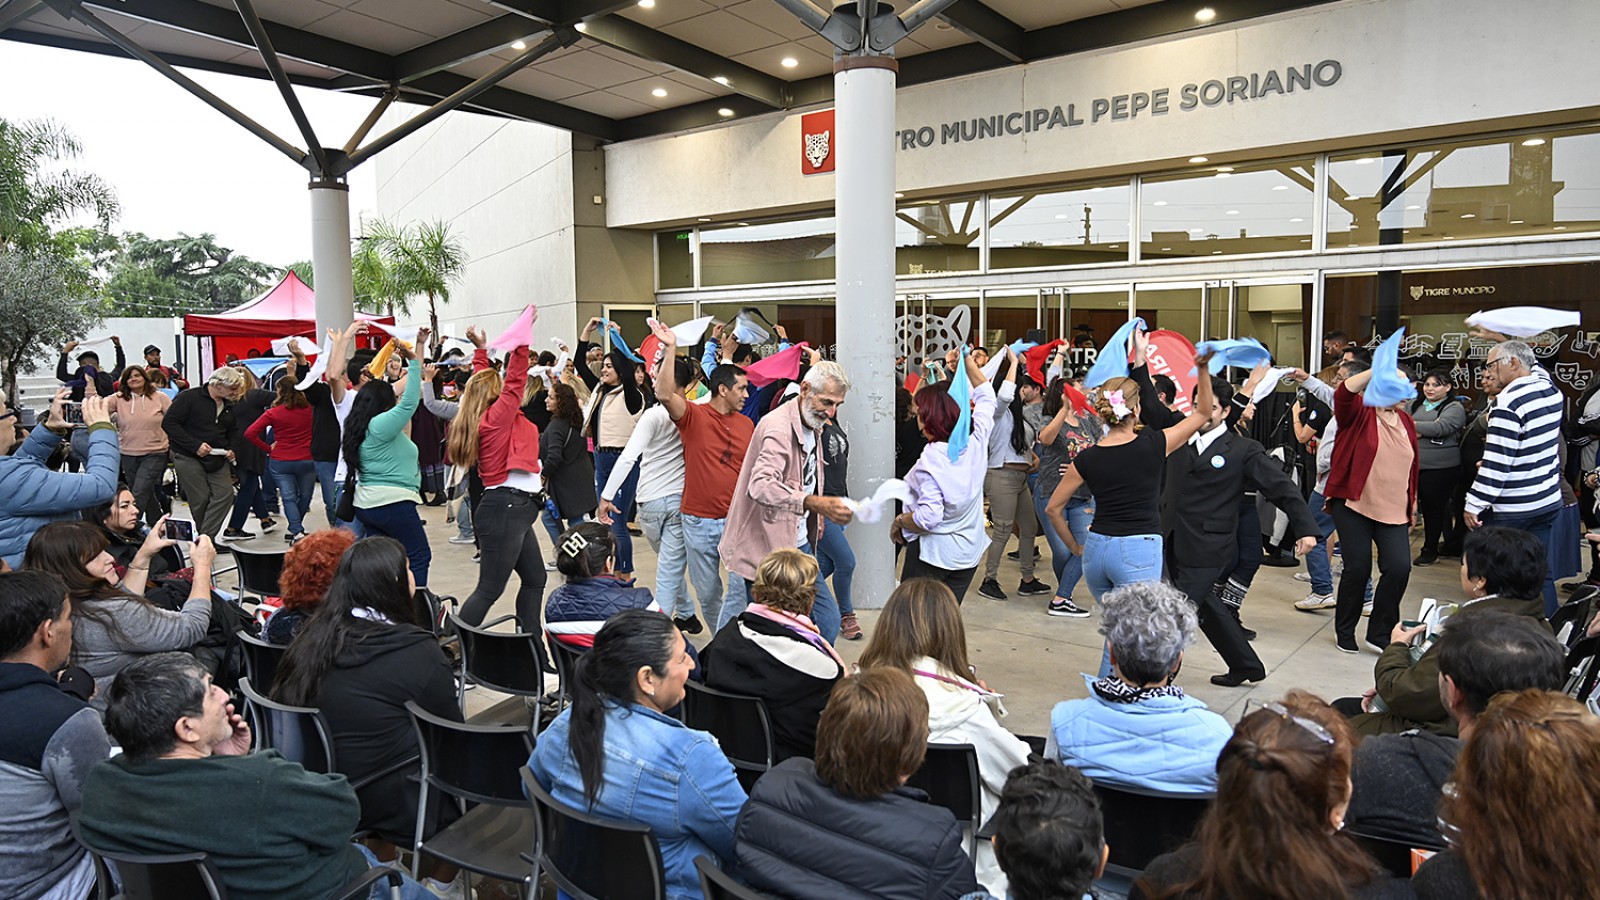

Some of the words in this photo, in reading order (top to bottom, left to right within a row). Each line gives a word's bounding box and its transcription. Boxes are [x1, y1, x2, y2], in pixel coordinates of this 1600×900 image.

[941, 103, 1083, 145] MUNICIPAL
[1092, 88, 1169, 122] PEPE
[1180, 59, 1342, 109] SORIANO
[1424, 288, 1450, 297] TIGRE
